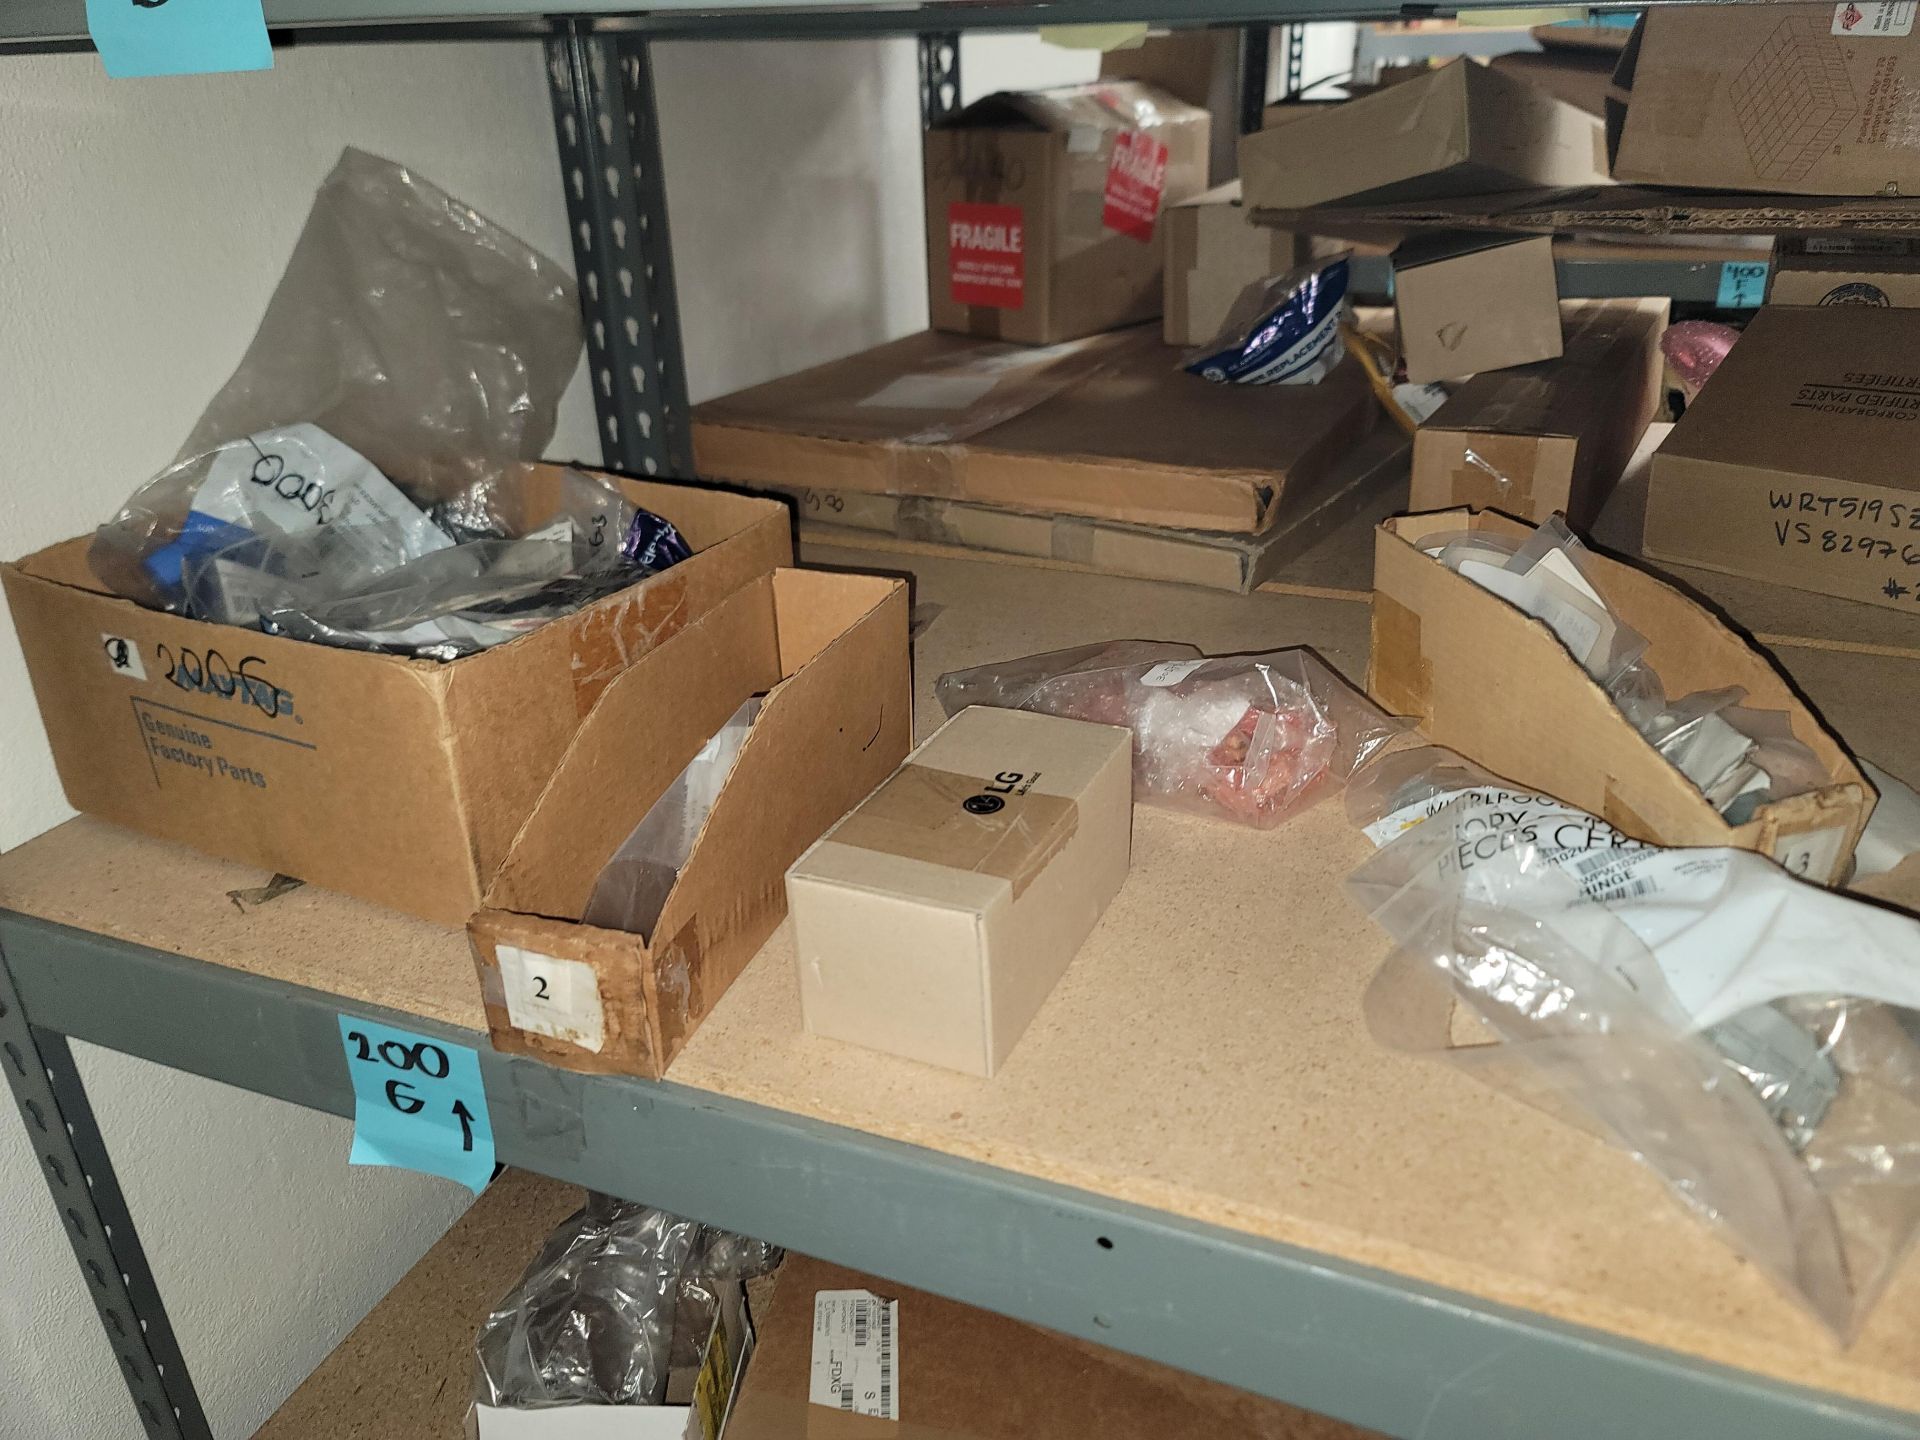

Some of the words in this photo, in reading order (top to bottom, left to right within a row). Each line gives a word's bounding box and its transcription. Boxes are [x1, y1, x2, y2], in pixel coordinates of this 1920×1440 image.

[950, 222, 1022, 253] FRAGILE
[1798, 388, 1853, 404] PARTS
[1810, 403, 1918, 421] CORPORATION
[141, 711, 213, 749] Genuine
[149, 736, 214, 777] Factory
[216, 756, 267, 789] Parts
[984, 770, 1024, 794] LG
[1579, 867, 1638, 897] HINGE
[532, 976, 551, 1000] 2
[347, 1031, 450, 1079] 200
[385, 1079, 426, 1114] G
[830, 1360, 843, 1394] FDXG
